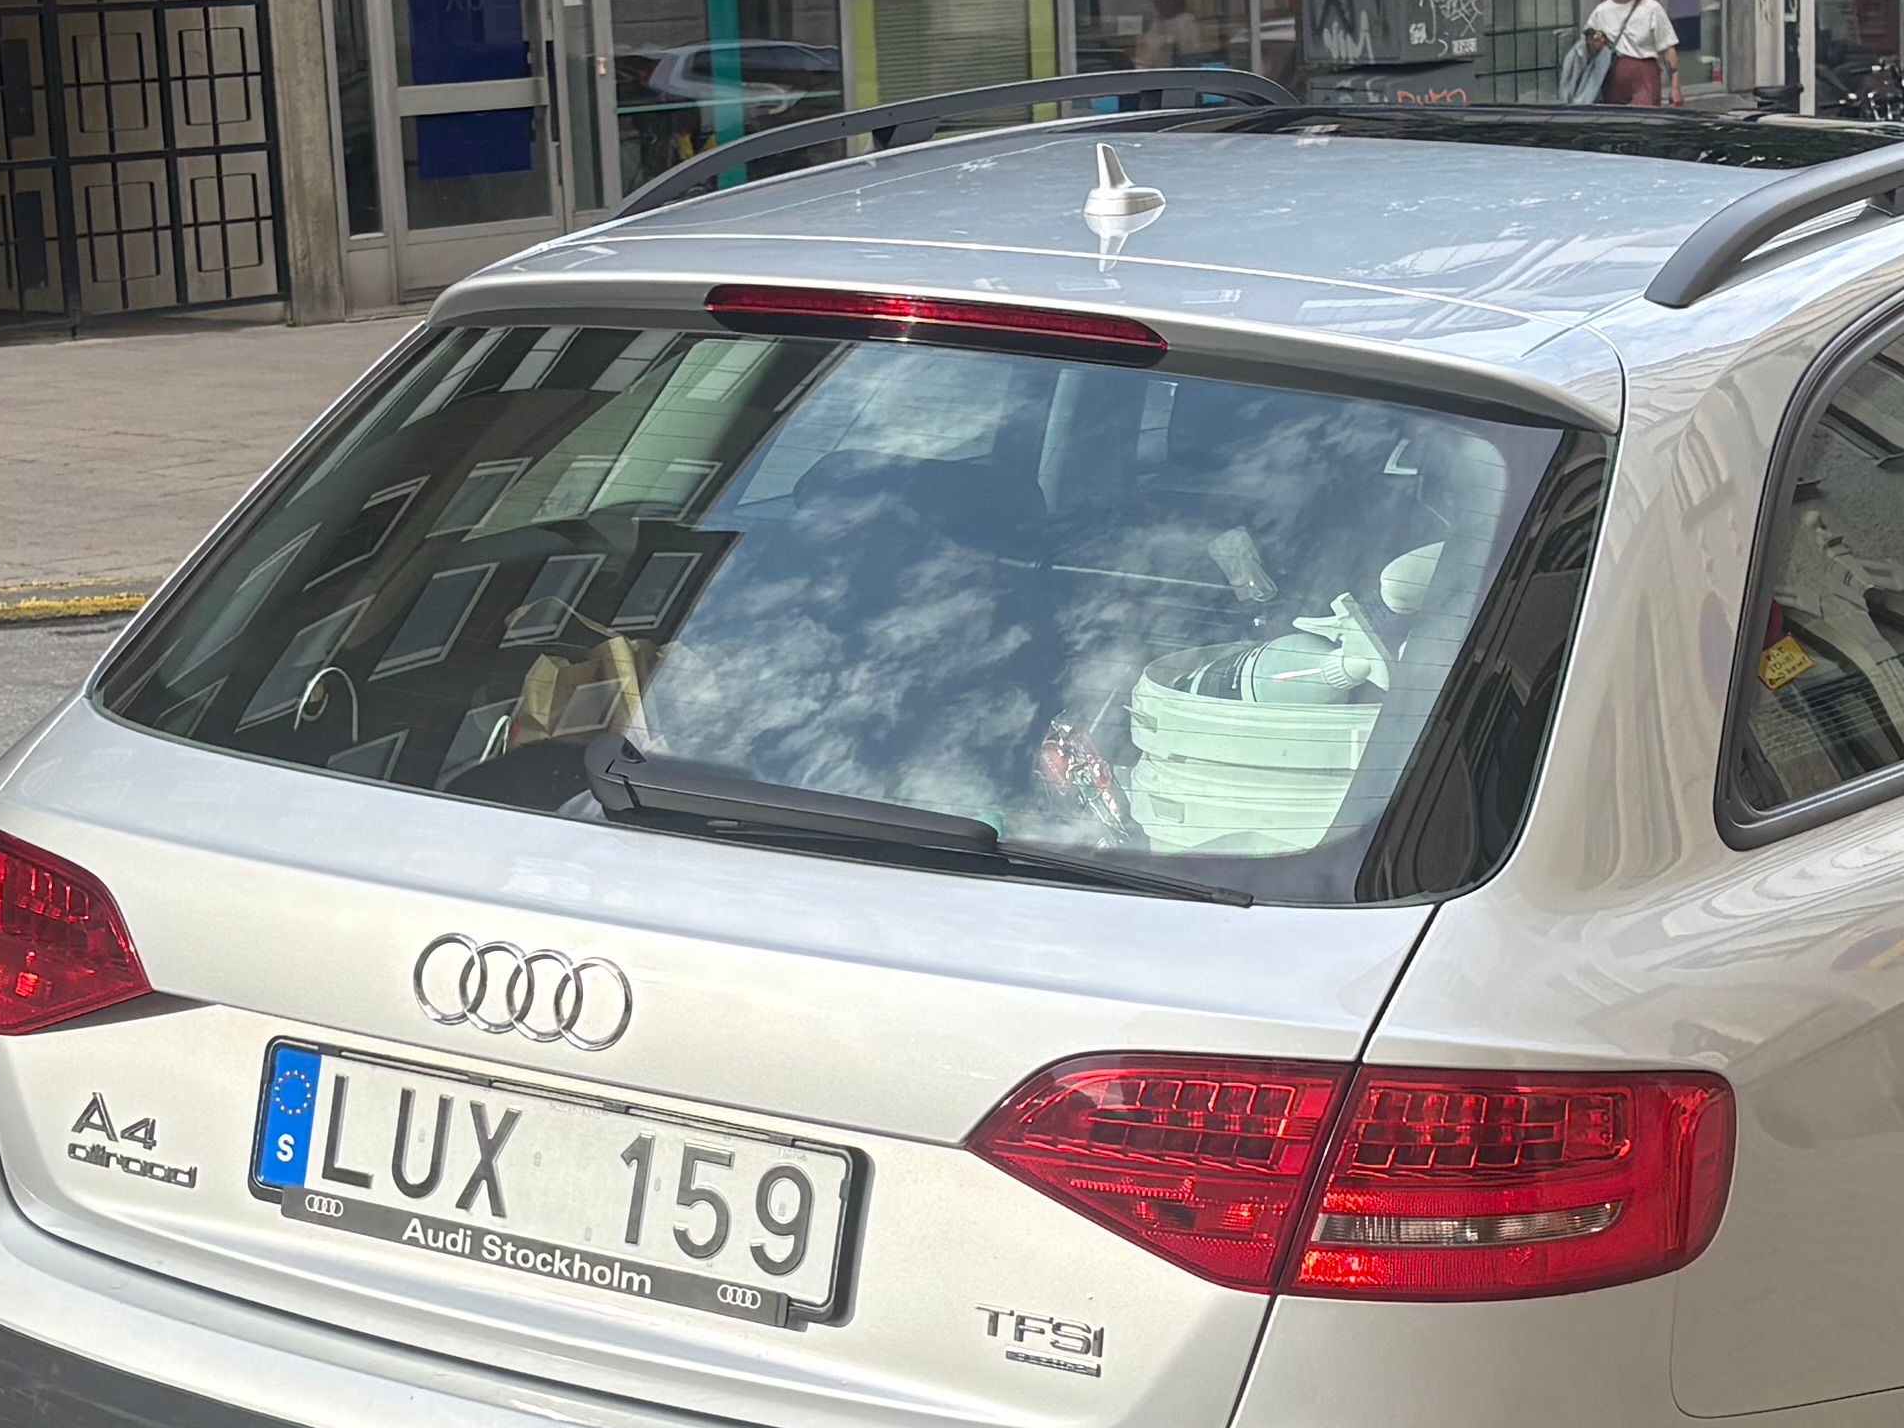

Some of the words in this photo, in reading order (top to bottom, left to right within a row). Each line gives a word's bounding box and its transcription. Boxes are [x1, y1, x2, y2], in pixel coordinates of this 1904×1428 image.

[71, 1091, 157, 1151] A4
[276, 1133, 295, 1162] S
[321, 1074, 523, 1219] LUX
[620, 1130, 815, 1277] 159
[402, 1217, 473, 1255] Audi
[481, 1233, 652, 1295] Stockholm
[974, 1302, 1105, 1358] TFSI
